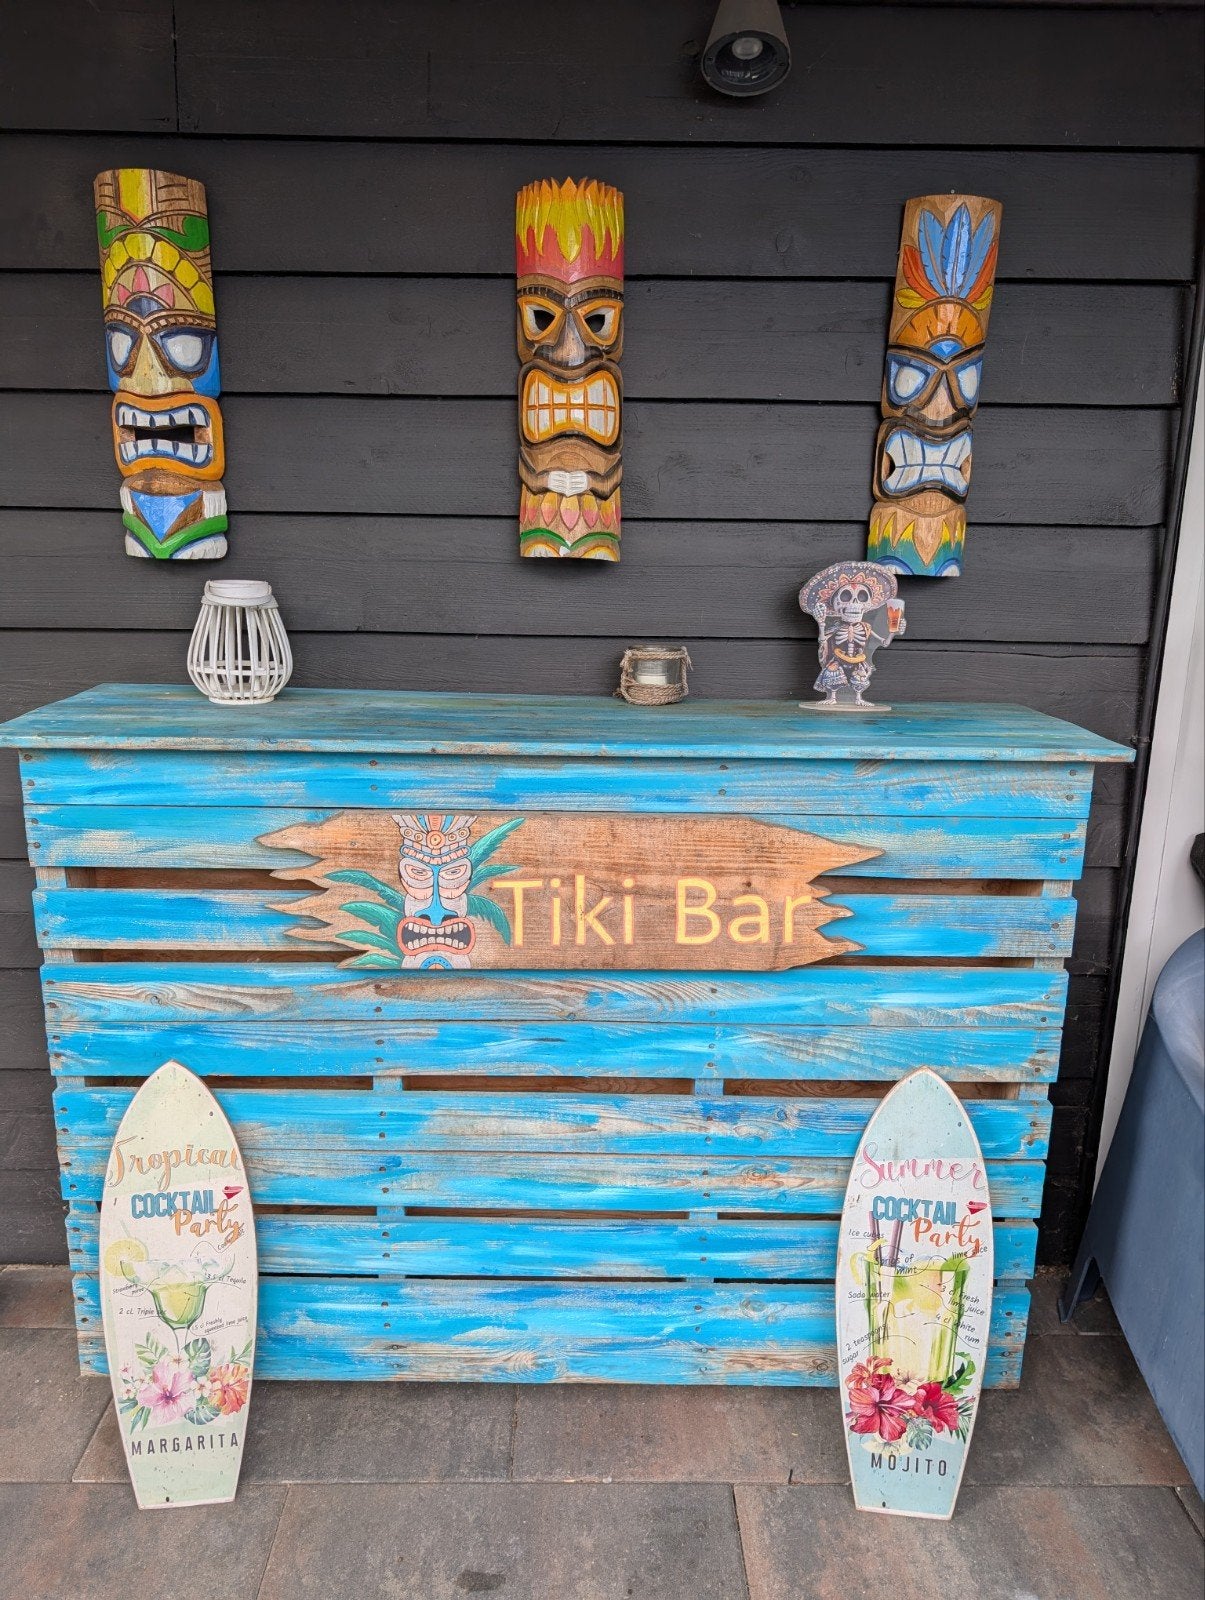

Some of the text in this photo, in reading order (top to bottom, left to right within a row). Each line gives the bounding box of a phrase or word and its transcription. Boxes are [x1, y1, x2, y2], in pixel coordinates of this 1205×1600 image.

[491, 873, 813, 947] Tiki Bar
[105, 1135, 241, 1191] Tropical
[859, 1141, 986, 1189] Summer
[131, 1189, 217, 1219] COCKTAIL
[872, 1195, 959, 1225] COCKTAIL
[169, 1198, 245, 1245] Party
[909, 1214, 984, 1259] Party
[964, 1303, 985, 1316] juice
[963, 1334, 981, 1345] rum
[841, 1350, 860, 1365] sugar
[131, 1432, 239, 1456] MARGARITA
[870, 1452, 948, 1477] MOJITO
